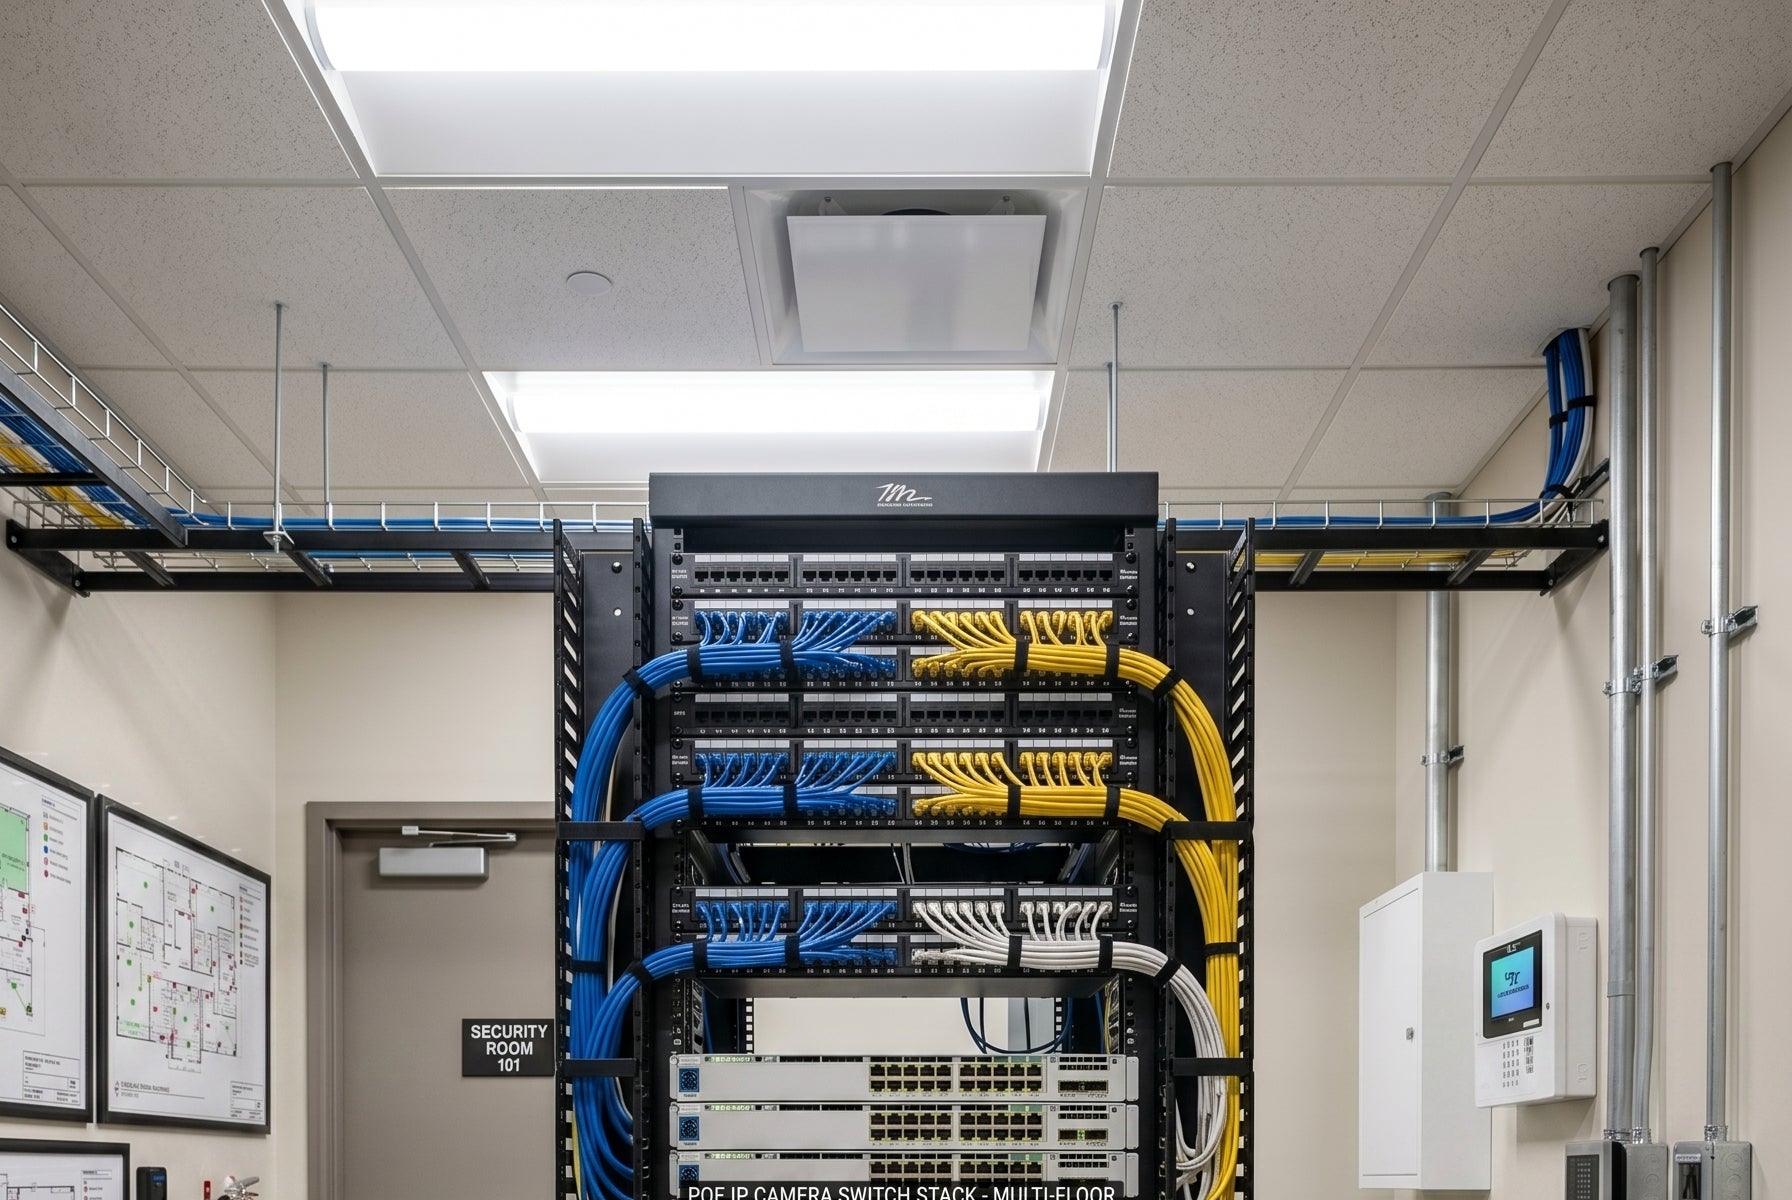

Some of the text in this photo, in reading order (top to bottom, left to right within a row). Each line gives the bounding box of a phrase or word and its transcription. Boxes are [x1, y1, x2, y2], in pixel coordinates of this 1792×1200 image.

[470, 1024, 548, 1039] SECURITY
[486, 1041, 533, 1056] ROOM
[497, 1057, 520, 1072] 101
